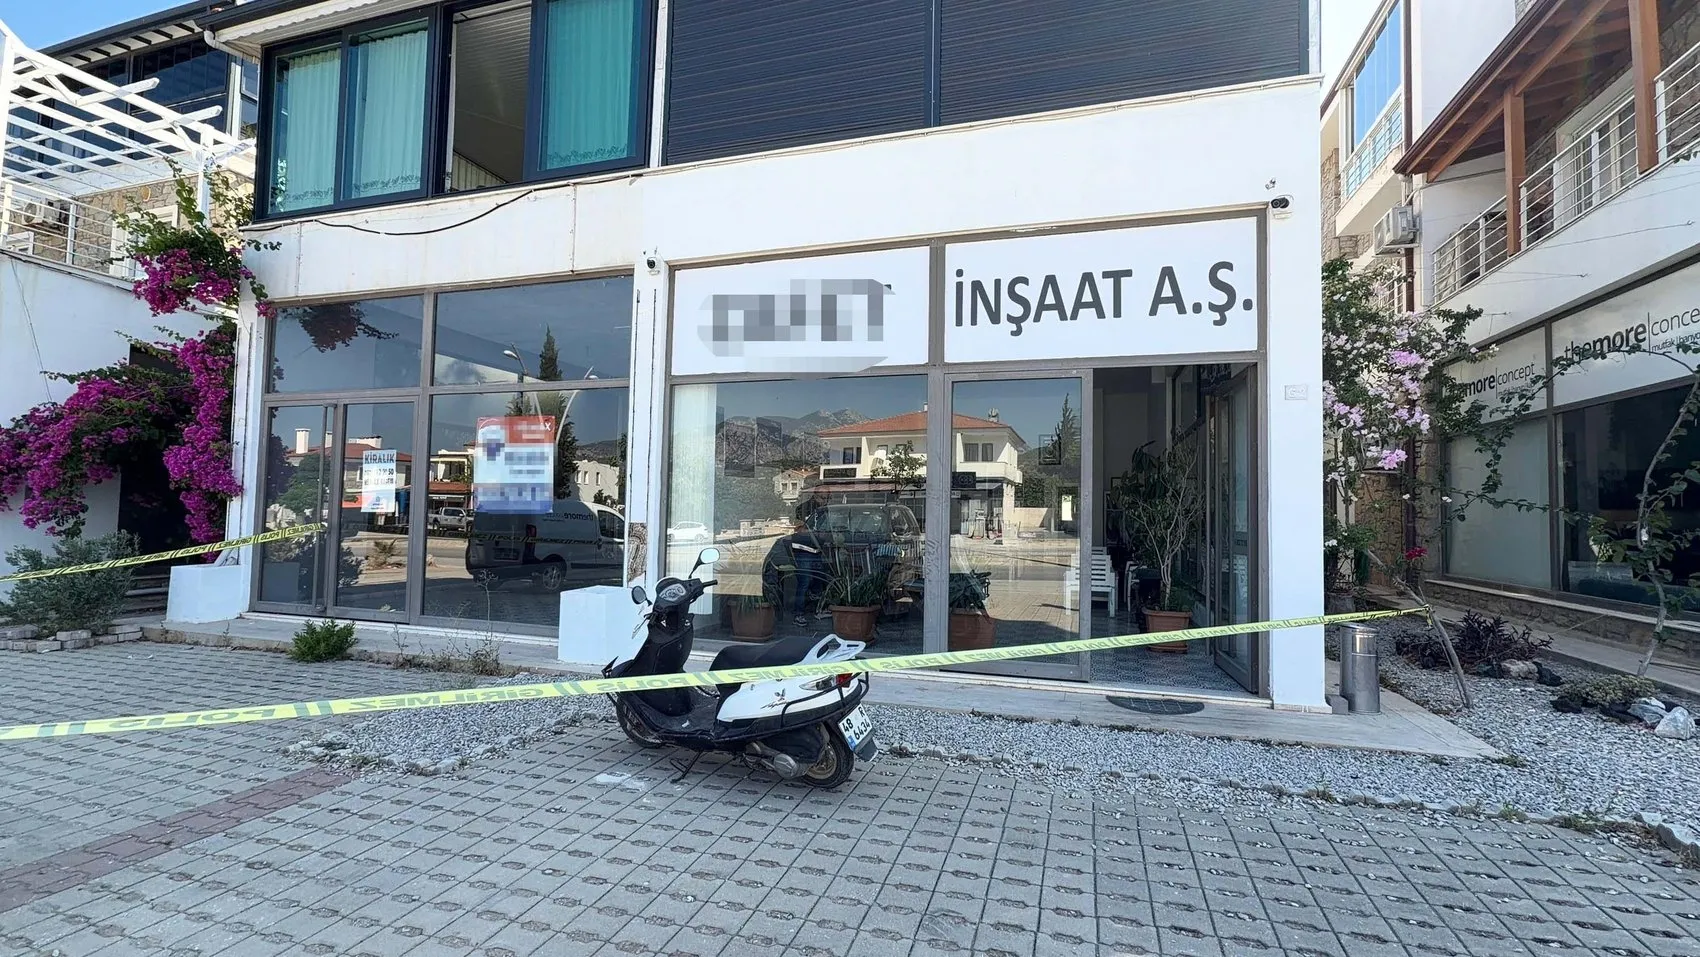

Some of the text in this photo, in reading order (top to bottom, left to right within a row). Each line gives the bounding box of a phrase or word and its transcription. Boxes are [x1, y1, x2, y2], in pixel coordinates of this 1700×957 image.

[955, 268, 1133, 337] İNŞAAT
[1148, 261, 1253, 327] A.Ş.
[1497, 363, 1535, 386] concept
[364, 452, 395, 464] KİRALIK
[842, 718, 854, 732] 48
[853, 719, 870, 739] 6434
